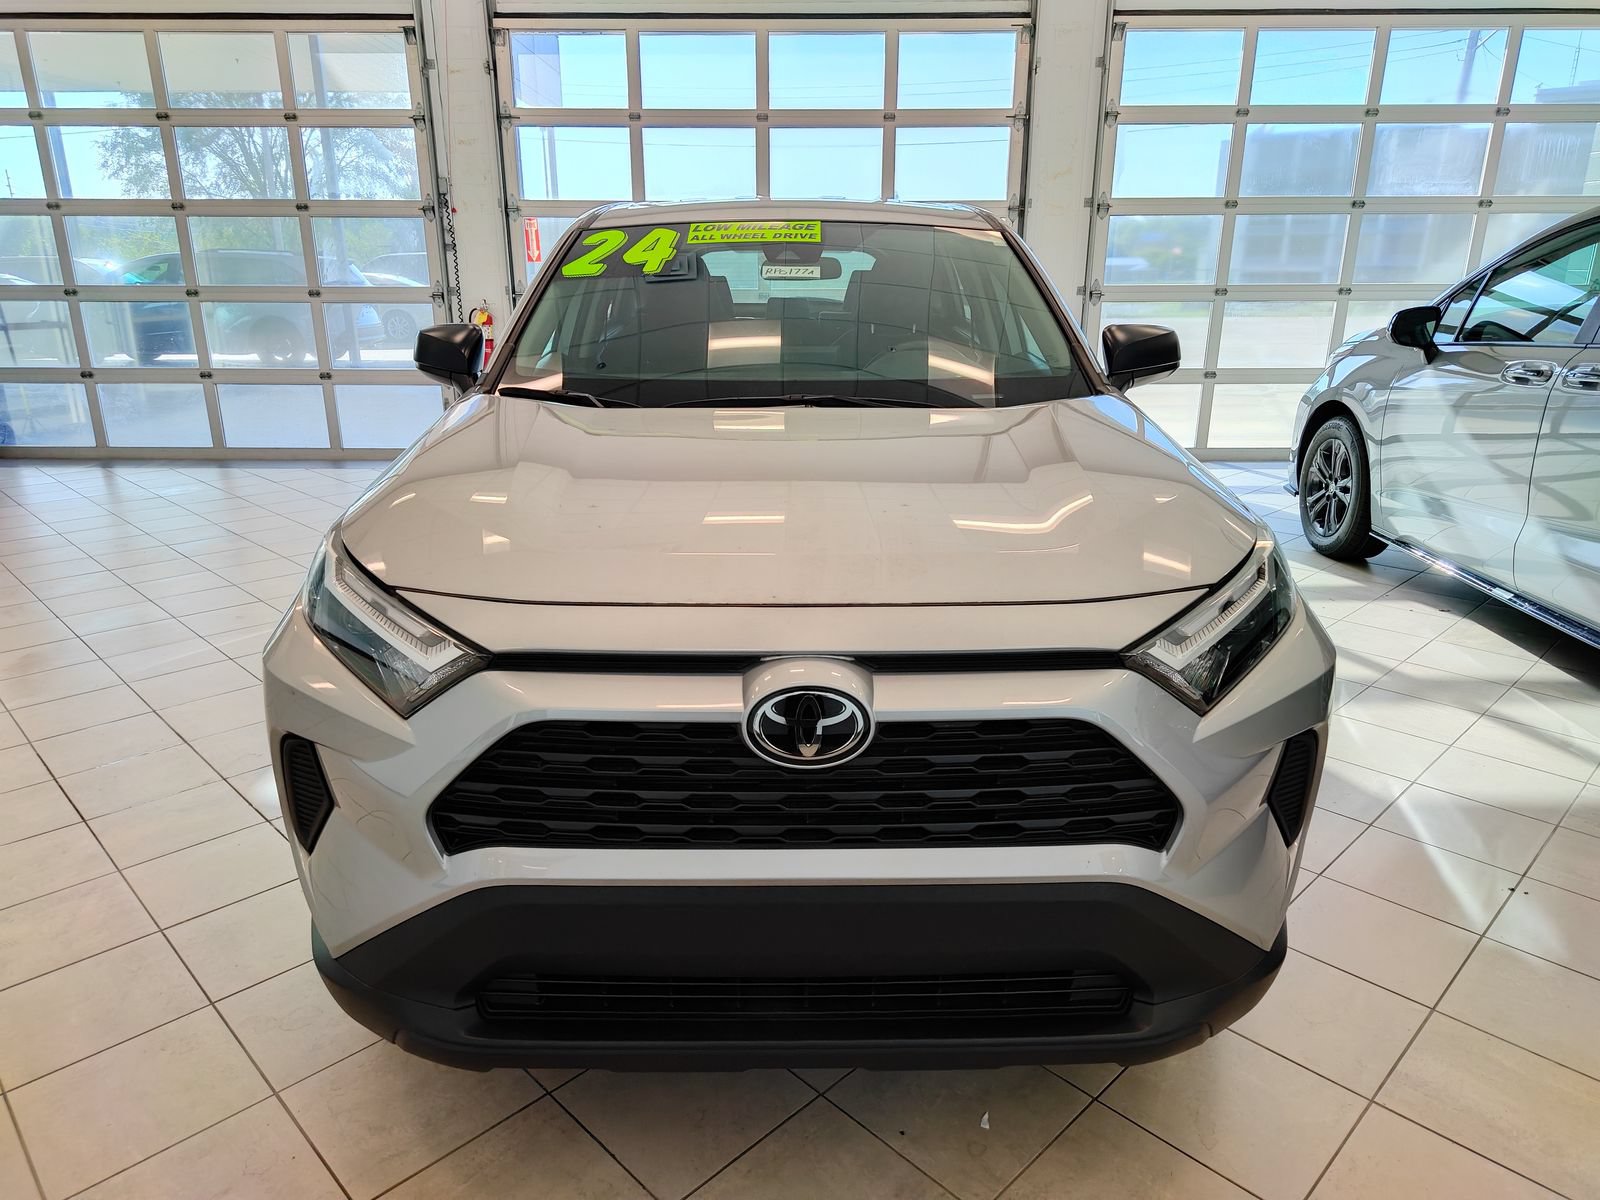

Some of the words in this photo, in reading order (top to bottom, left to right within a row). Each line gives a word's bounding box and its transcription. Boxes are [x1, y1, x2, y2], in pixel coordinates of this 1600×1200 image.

[692, 223, 732, 232] LOW
[736, 223, 817, 231] MILEAGE
[562, 228, 680, 277] 24
